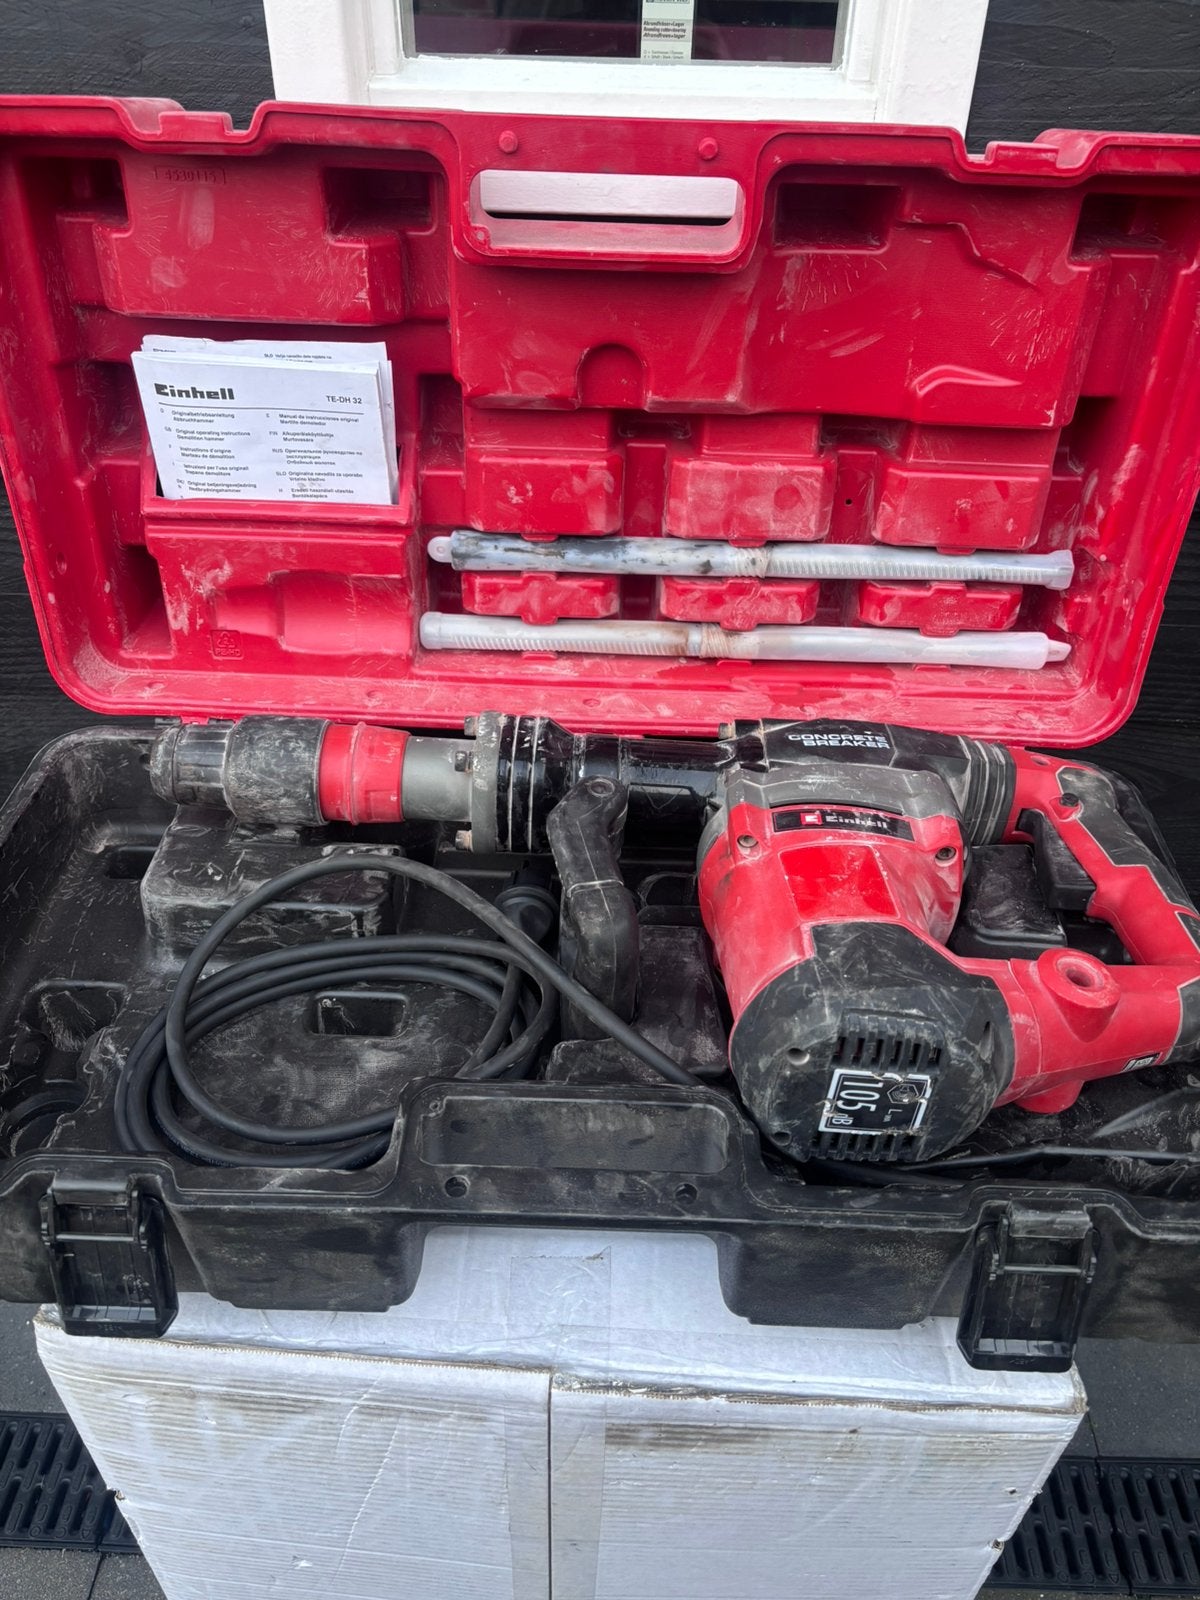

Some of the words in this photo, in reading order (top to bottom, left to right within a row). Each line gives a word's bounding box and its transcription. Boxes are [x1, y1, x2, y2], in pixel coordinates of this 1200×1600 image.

[154, 383, 235, 400] Einhell
[326, 395, 351, 404] TE-DH
[788, 734, 887, 742] CONCRETE
[803, 740, 890, 749] BREAKER
[826, 815, 888, 829] Einhell
[836, 1081, 884, 1112] 105
